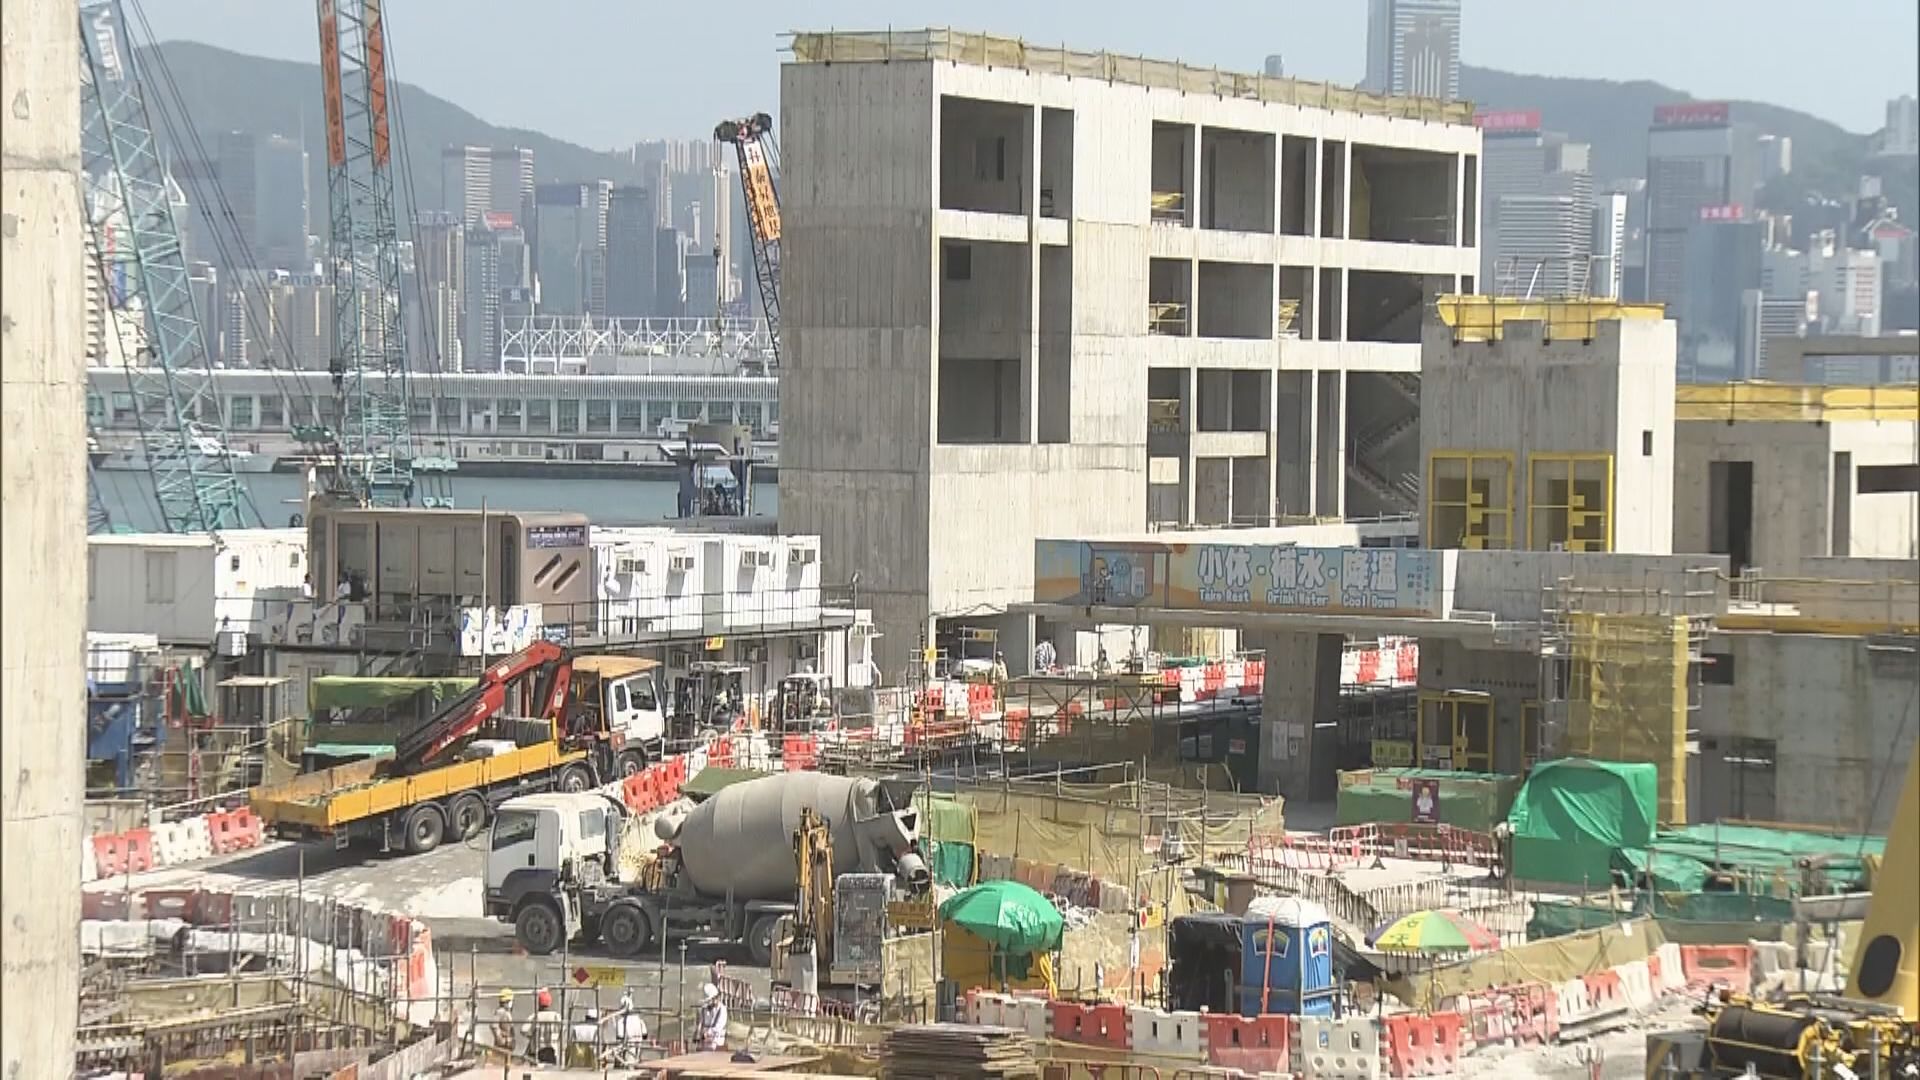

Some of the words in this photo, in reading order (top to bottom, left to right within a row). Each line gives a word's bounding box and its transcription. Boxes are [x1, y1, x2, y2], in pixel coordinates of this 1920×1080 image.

[1200, 588, 1223, 602] Take
[1225, 588, 1250, 603] Rest
[1266, 589, 1295, 605] Drink
[1297, 590, 1329, 607] Water
[1342, 592, 1367, 608] Cool
[1370, 593, 1397, 608] Down
